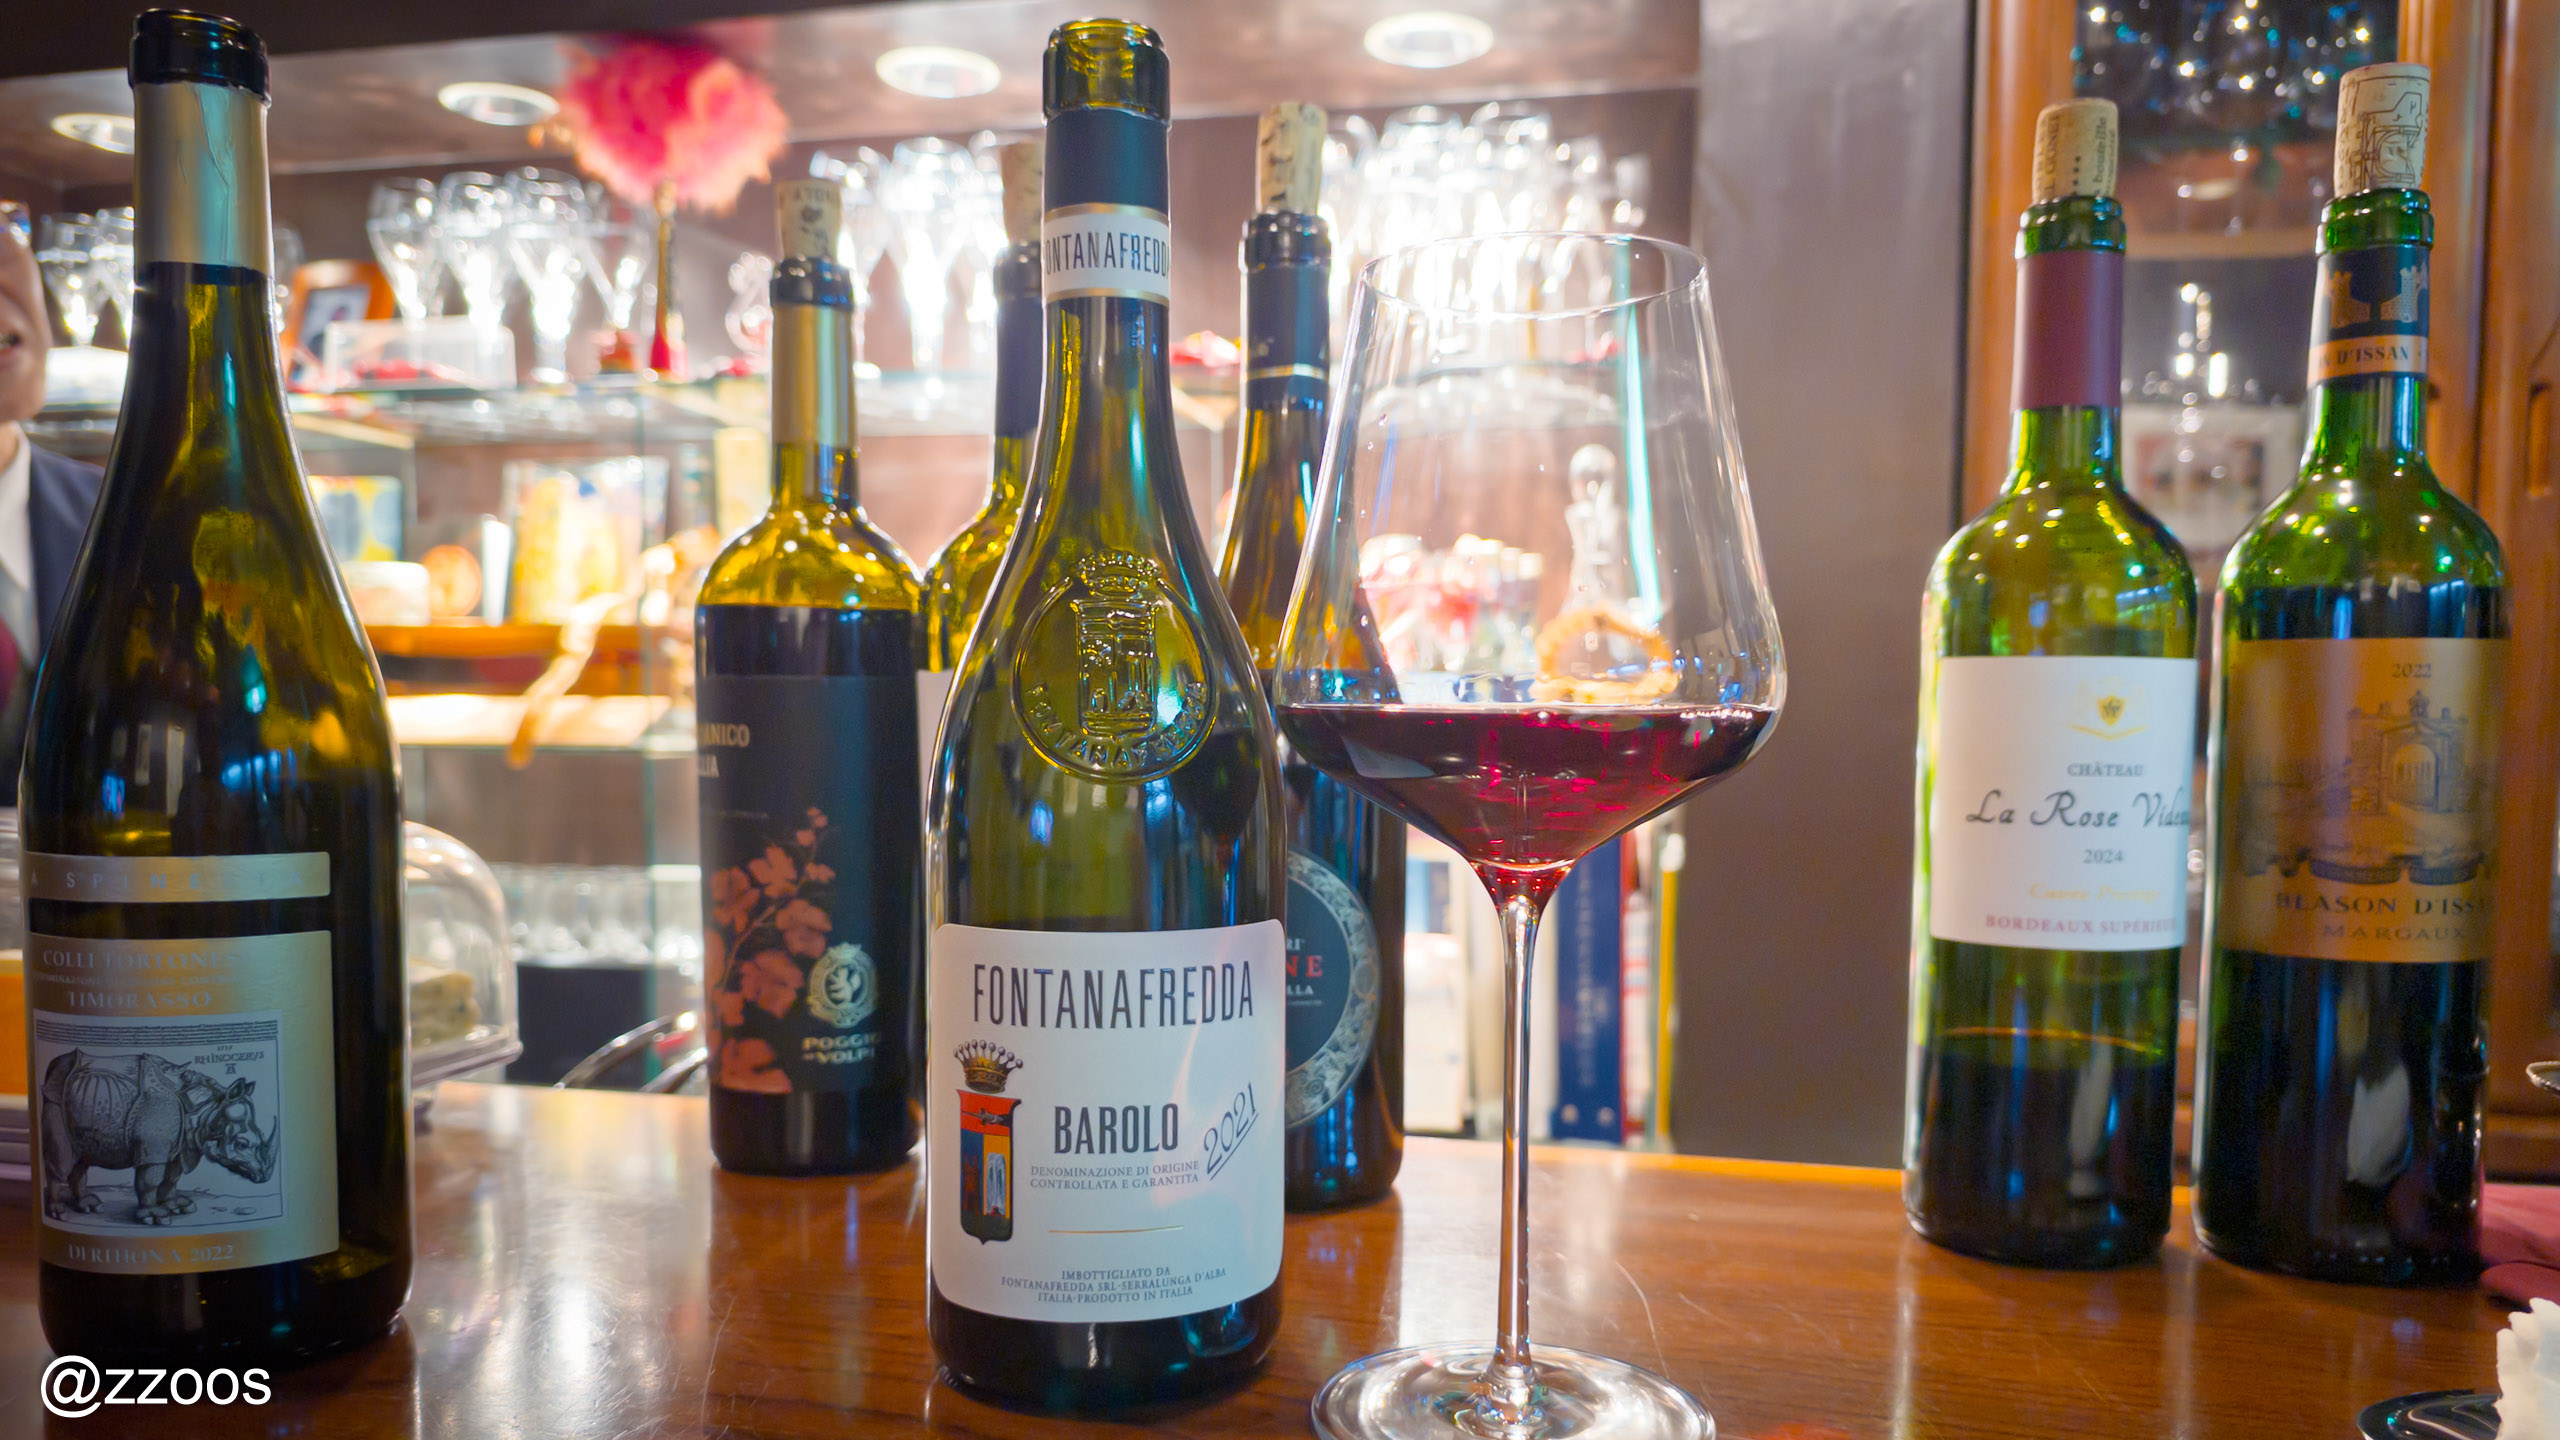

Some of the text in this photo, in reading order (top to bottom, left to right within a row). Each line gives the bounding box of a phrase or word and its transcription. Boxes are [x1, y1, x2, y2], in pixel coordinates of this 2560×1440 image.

[1045, 231, 1169, 281] ONTANAFREDD
[2337, 345, 2409, 365] D'ISSAN
[2391, 662, 2433, 679] 2022
[697, 722, 751, 748] ANICO
[2066, 761, 2145, 778] CHÂTEAU
[1965, 785, 2190, 828] La Rose Vide
[2083, 849, 2124, 864] 2024
[2276, 891, 2474, 915] BLASON D'ISS
[1985, 914, 2094, 934] BORDEAUX
[2323, 925, 2465, 941] MARGAUX
[43, 949, 242, 970] COLLI TORTONES
[973, 960, 1254, 1029] FONTANAFREDDA
[1054, 1102, 1179, 1155] BAROLO
[1202, 1082, 1259, 1176] 2021
[1030, 1160, 1200, 1178] DENOMINAZIONE DI ORIGINE
[1030, 1174, 1200, 1190] CONTROLLATA E GARANTITA
[189, 1244, 236, 1263] 2022
[1001, 1276, 1094, 1292] FONTANAFREDDA
[1194, 1267, 1227, 1283] D'ALBA
[1061, 1267, 1171, 1281] IMBOTTIGLIATO DA
[1144, 1290, 1157, 1301] IN
[1160, 1286, 1193, 1299] ITALIA
